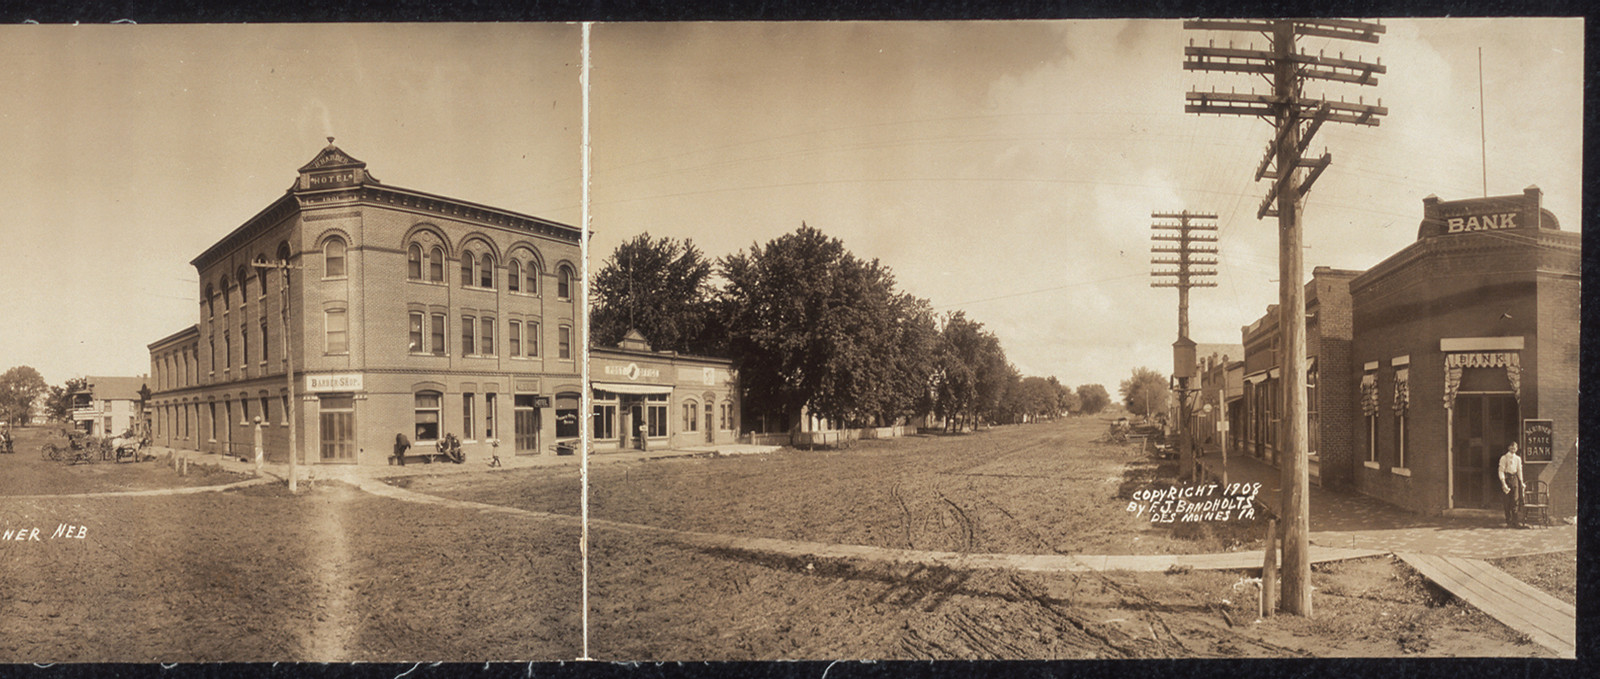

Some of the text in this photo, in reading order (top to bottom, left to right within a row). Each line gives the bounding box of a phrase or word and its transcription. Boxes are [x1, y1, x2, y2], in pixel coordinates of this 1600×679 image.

[314, 175, 349, 185] HOTEL
[1447, 213, 1517, 233] BANK
[1460, 354, 1504, 364] BANK
[604, 366, 628, 376] POST
[311, 378, 339, 388] BARBER
[1528, 436, 1550, 444] STATE
[1527, 446, 1551, 456] BANK
